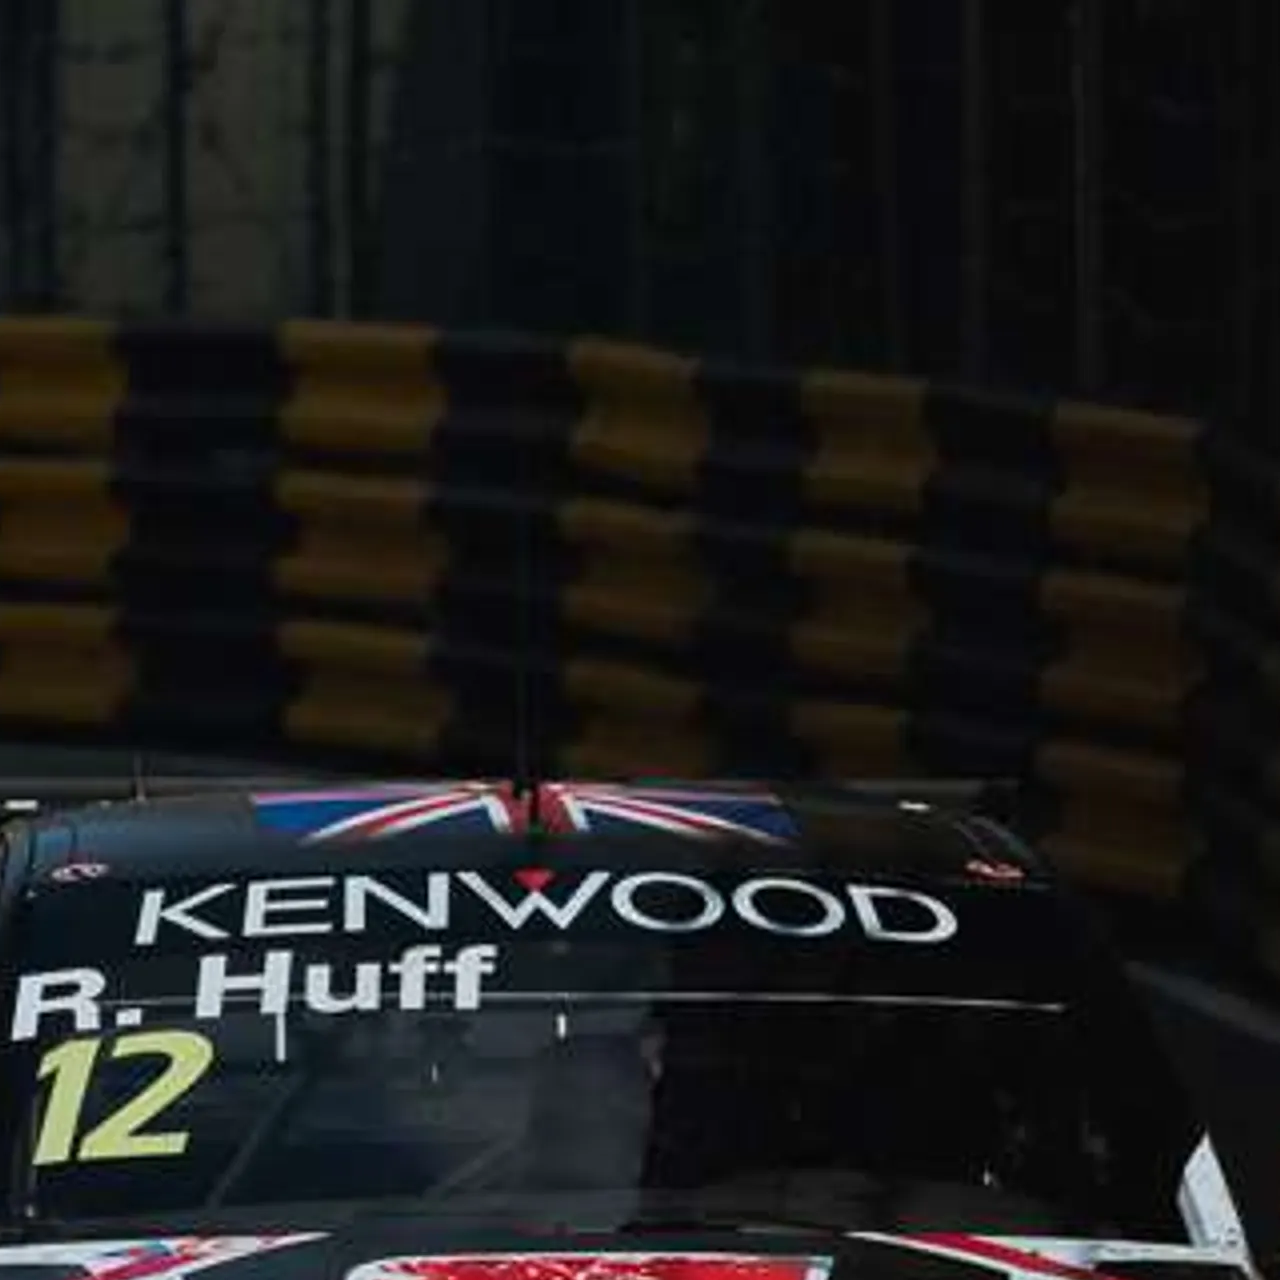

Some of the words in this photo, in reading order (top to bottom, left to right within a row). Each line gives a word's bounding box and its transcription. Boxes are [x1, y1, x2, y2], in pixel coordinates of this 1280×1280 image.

[133, 870, 959, 946] KENWOOD
[10, 965, 143, 1041] R.
[194, 943, 498, 1020] Huff
[31, 1029, 215, 1167] 12
